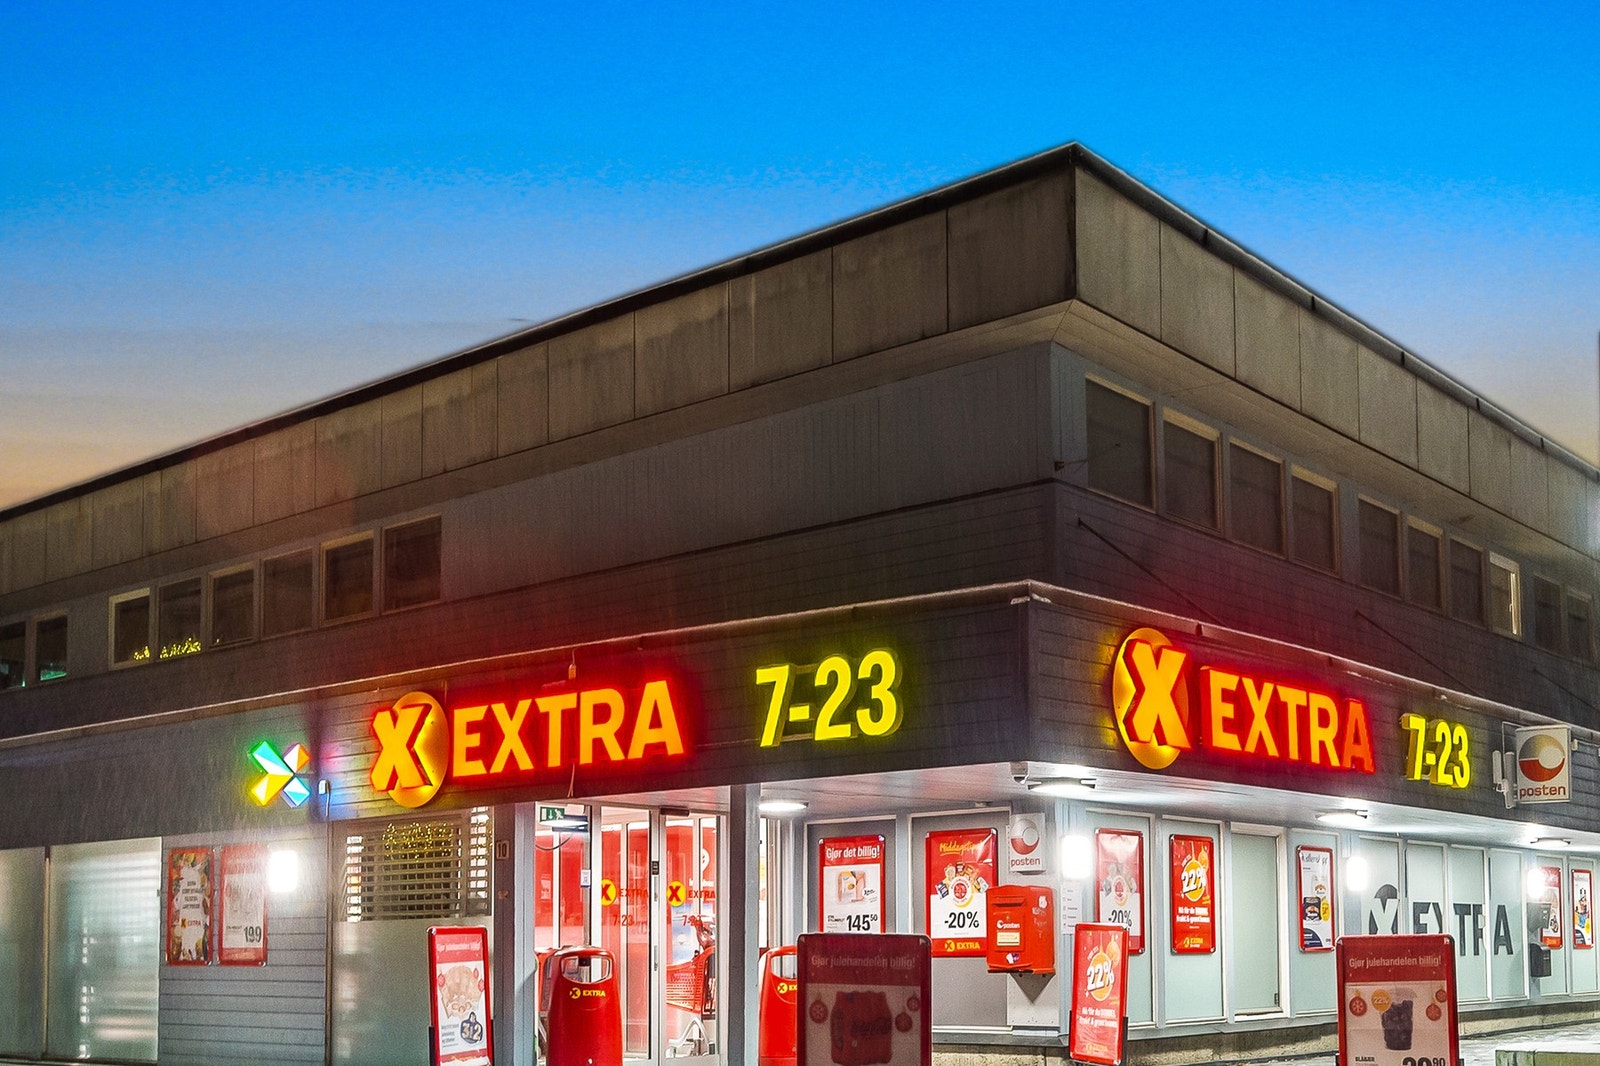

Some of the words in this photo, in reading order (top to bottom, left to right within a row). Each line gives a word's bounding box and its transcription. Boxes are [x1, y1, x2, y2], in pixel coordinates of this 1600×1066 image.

[756, 650, 897, 747] 7-23
[452, 680, 684, 777] EXTRA
[1206, 668, 1376, 774] EXTRA
[1404, 714, 1471, 788] 7-23
[1519, 784, 1567, 800] posten
[843, 847, 857, 858] det
[1010, 857, 1041, 867] posten
[846, 914, 871, 931] 145
[870, 914, 878, 922] 50
[944, 911, 980, 928] -20%
[244, 926, 262, 943] 199
[1349, 958, 1365, 969] Gjør
[1366, 956, 1418, 969] julehandelen
[1086, 961, 1115, 992] 22%
[582, 990, 606, 998] EXTRA
